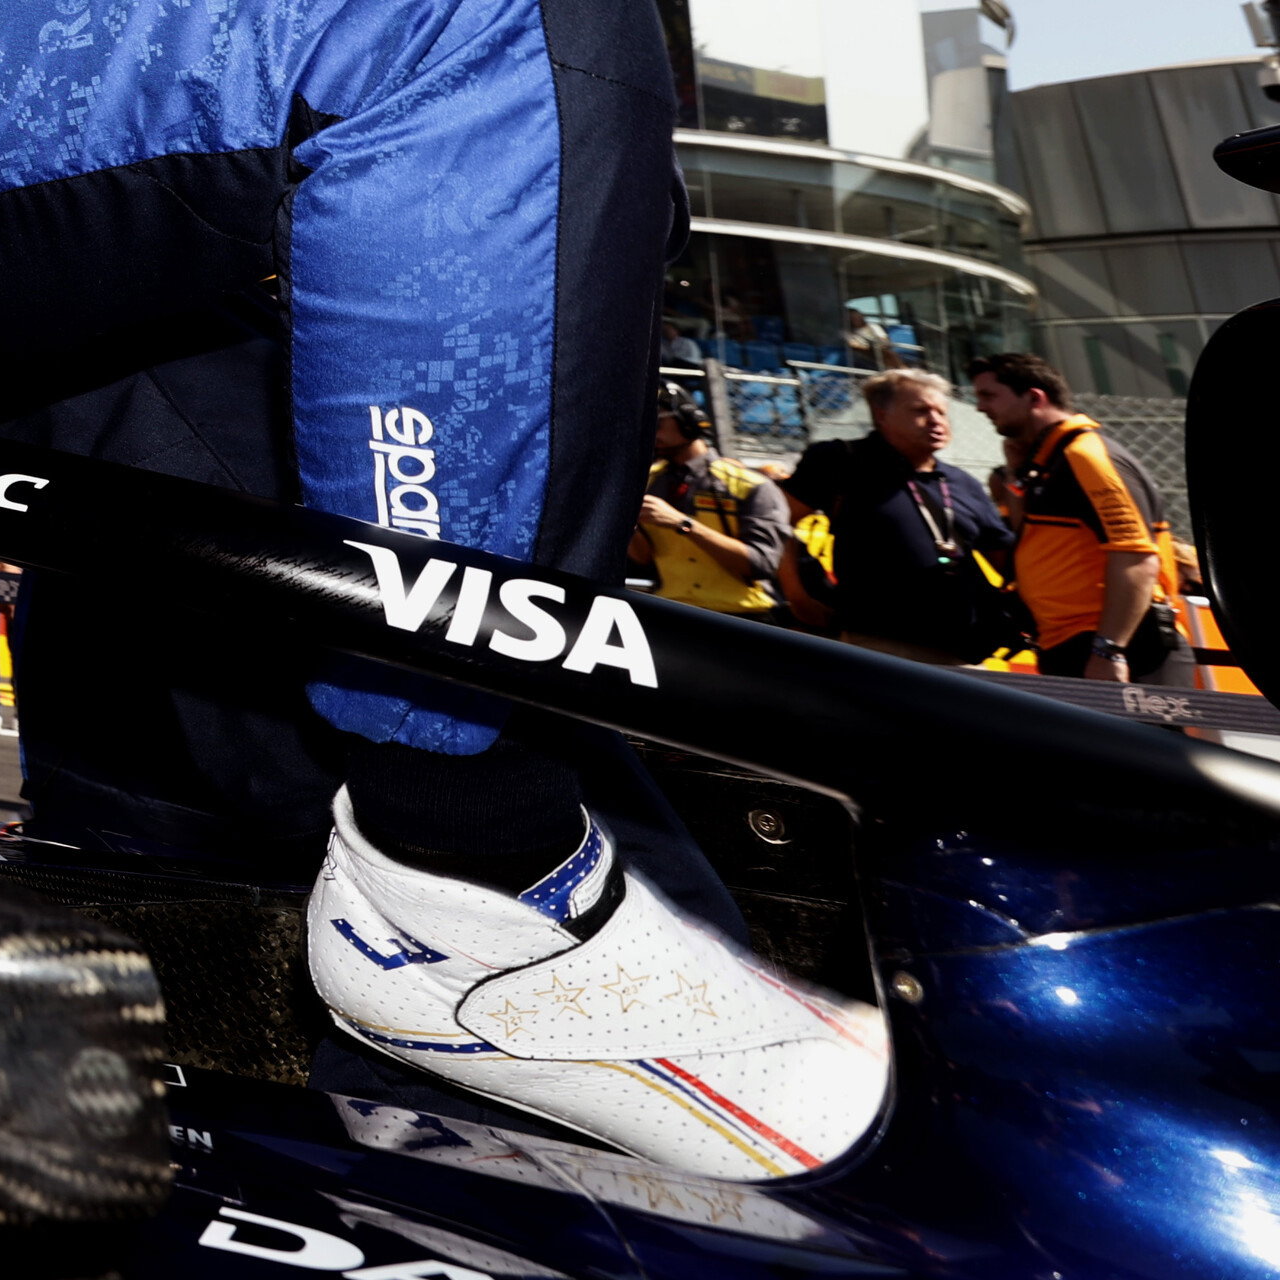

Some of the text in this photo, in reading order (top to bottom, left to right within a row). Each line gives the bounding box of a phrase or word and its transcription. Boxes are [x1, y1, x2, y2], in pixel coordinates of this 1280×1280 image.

[369, 406, 440, 541] spar
[343, 539, 659, 689] VISA
[554, 993, 571, 1004] 22
[623, 985, 639, 997] 23
